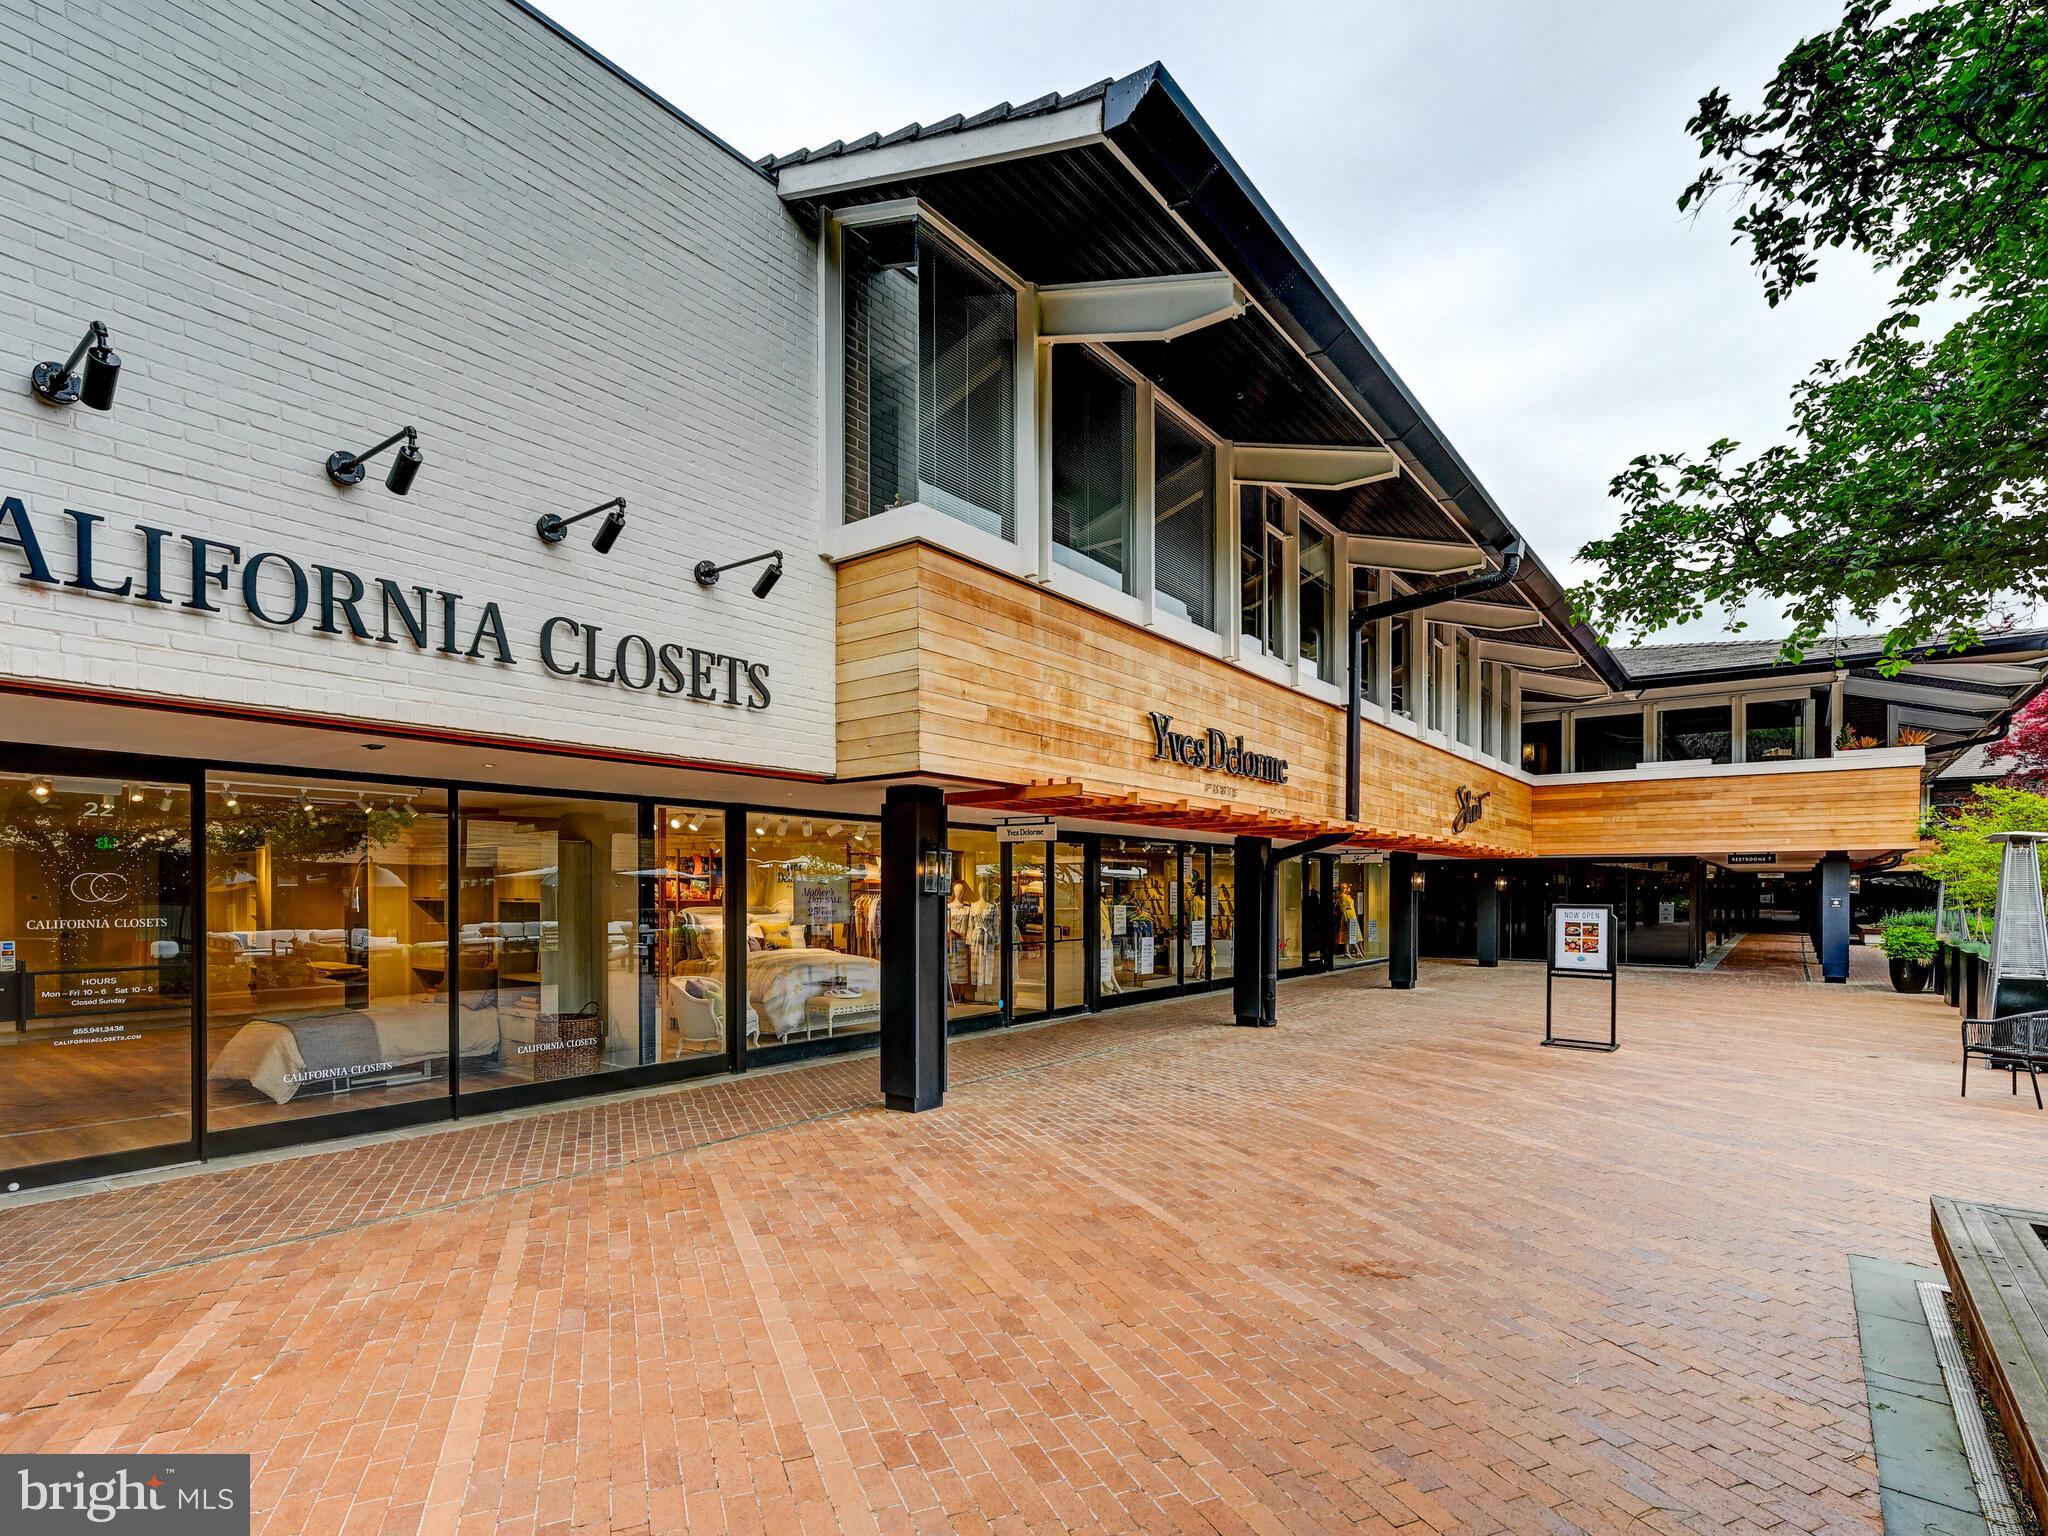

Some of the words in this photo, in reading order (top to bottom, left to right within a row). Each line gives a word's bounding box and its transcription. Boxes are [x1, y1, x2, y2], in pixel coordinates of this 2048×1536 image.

[540, 616, 771, 710] CLOSETS
[1149, 711, 1206, 769] Yves
[1207, 728, 1289, 784] Delorme
[84, 802, 114, 817] 22
[1006, 828, 1020, 836] Yves
[1020, 828, 1044, 836] Delorme
[26, 919, 110, 930] CALIFORNIA
[114, 918, 168, 928] CLOSETS
[81, 977, 117, 986] HOURS
[69, 989, 80, 997] Fri
[71, 998, 97, 1006] Closed
[98, 997, 127, 1005] Sunday
[53, 1034, 142, 1046] CALIFORNIACLOSETS.COM
[517, 1041, 565, 1054] CALIFORNIA
[566, 1037, 597, 1048] CLOSETS
[283, 1067, 348, 1083] CALIFORNIA
[350, 1061, 393, 1075] CLOSETS
